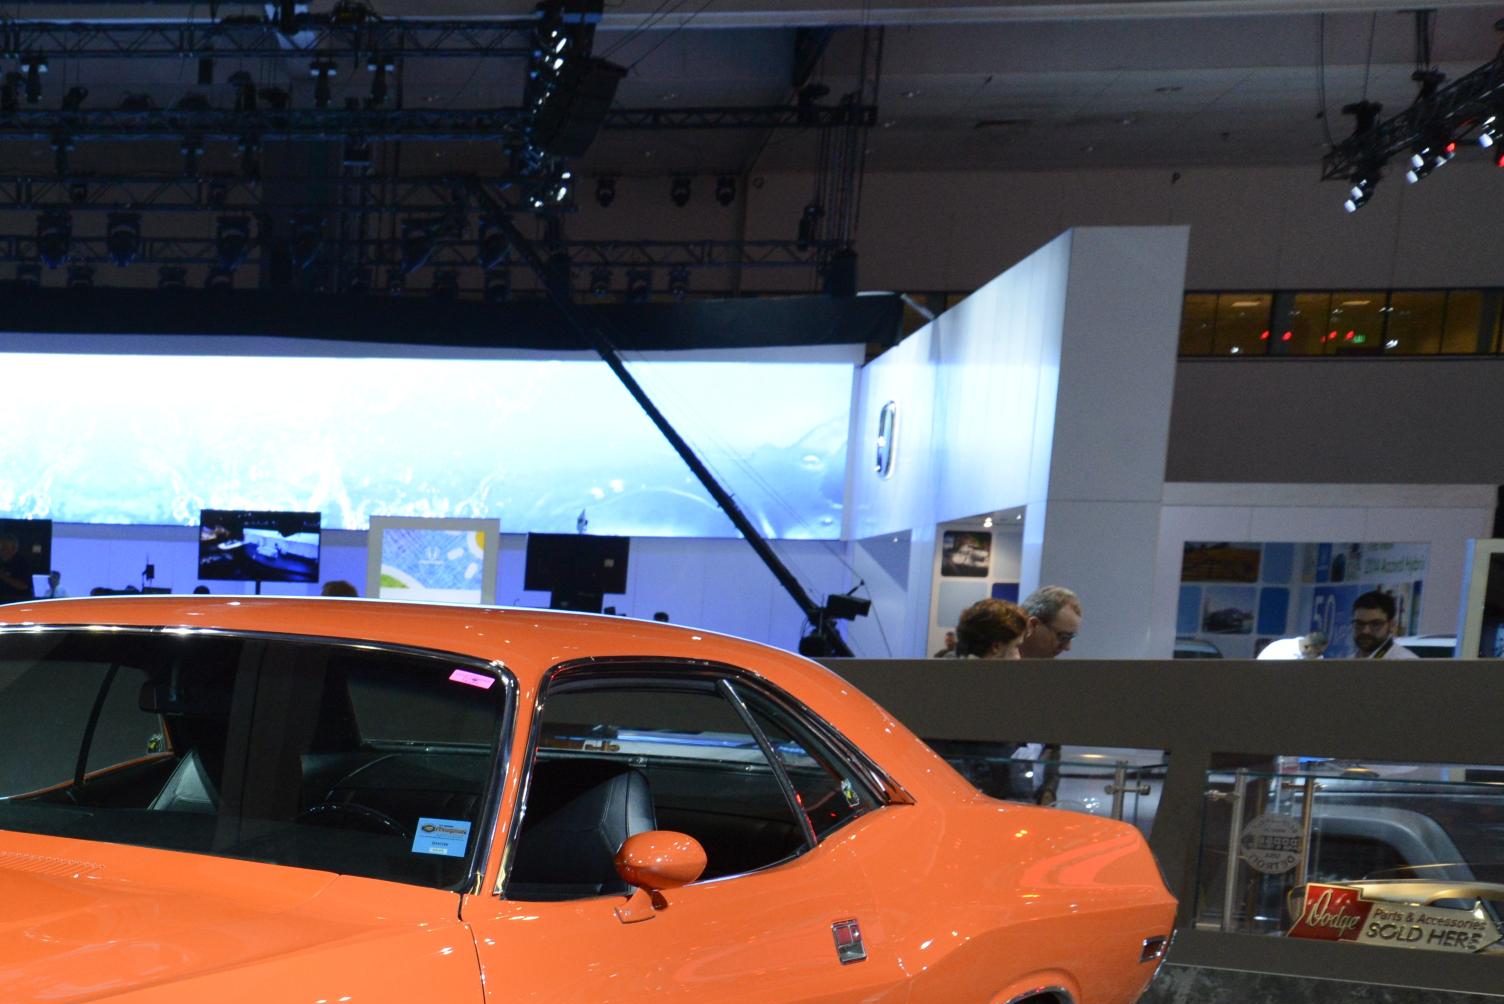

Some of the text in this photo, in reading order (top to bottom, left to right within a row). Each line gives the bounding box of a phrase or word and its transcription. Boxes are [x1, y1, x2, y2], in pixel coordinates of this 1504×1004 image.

[1307, 889, 1361, 936] Dodge
[1373, 908, 1487, 931] Parts & Accessories
[1366, 922, 1484, 950] SOLD HERE
